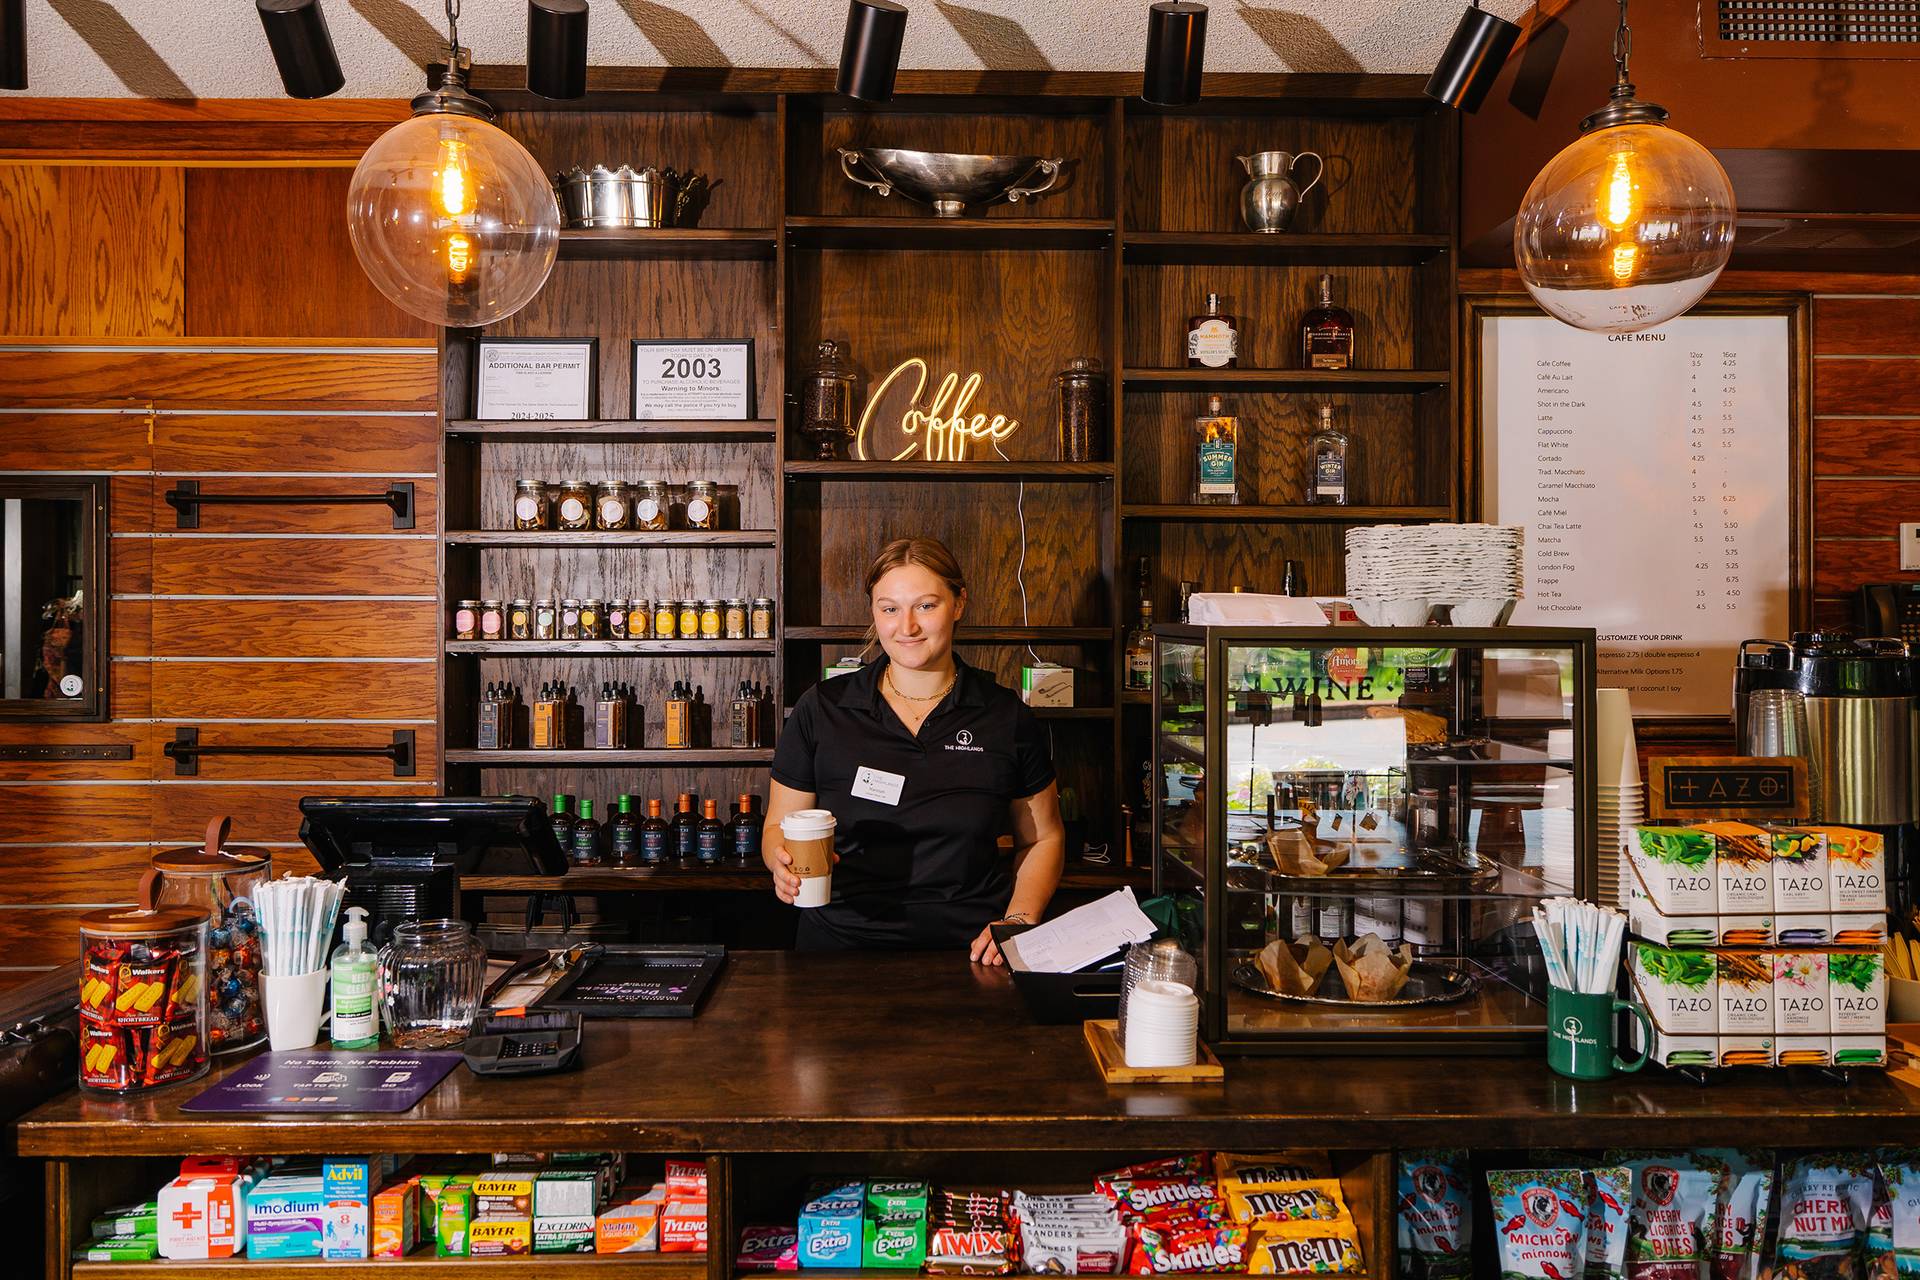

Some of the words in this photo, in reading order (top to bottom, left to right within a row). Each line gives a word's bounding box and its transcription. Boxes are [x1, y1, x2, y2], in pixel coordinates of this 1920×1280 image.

[1636, 333, 1666, 341] MENU
[661, 358, 722, 378] 2003
[857, 357, 1020, 461] Coffee
[1203, 453, 1233, 463] SUMMER
[1272, 676, 1375, 700] WINE
[1667, 878, 1711, 891] TAZO
[1722, 878, 1766, 891] TAZO
[1779, 878, 1823, 891] TAZO
[1835, 875, 1879, 889] TAZO
[1667, 998, 1712, 1012] TAZO
[1723, 998, 1767, 1012] TAZO
[1780, 998, 1824, 1011] TAZO
[1834, 997, 1879, 1011] TAZO
[327, 1167, 363, 1181] Advil
[478, 1183, 517, 1191] BAYER
[871, 1182, 922, 1194] Extra
[1130, 1183, 1214, 1211] Skittles
[254, 1201, 319, 1215] Imodium
[805, 1200, 859, 1212] Extra
[1647, 1209, 1682, 1223] CHERRY
[1793, 1217, 1827, 1232] NUT
[1831, 1214, 1855, 1232] MIX
[472, 1227, 515, 1236] BAYER
[538, 1222, 591, 1231] EXCEDRIN
[1027, 1229, 1073, 1238] SANDERS
[1650, 1222, 1688, 1236] LICORICE
[742, 1234, 796, 1253] Extra
[811, 1236, 848, 1253] Extra
[878, 1236, 913, 1253] Extra
[1510, 1232, 1579, 1246] MICHIGAN
[1652, 1237, 1693, 1257] BITES
[1155, 1242, 1242, 1273] Skittles
[1521, 1249, 1573, 1260] minnows
